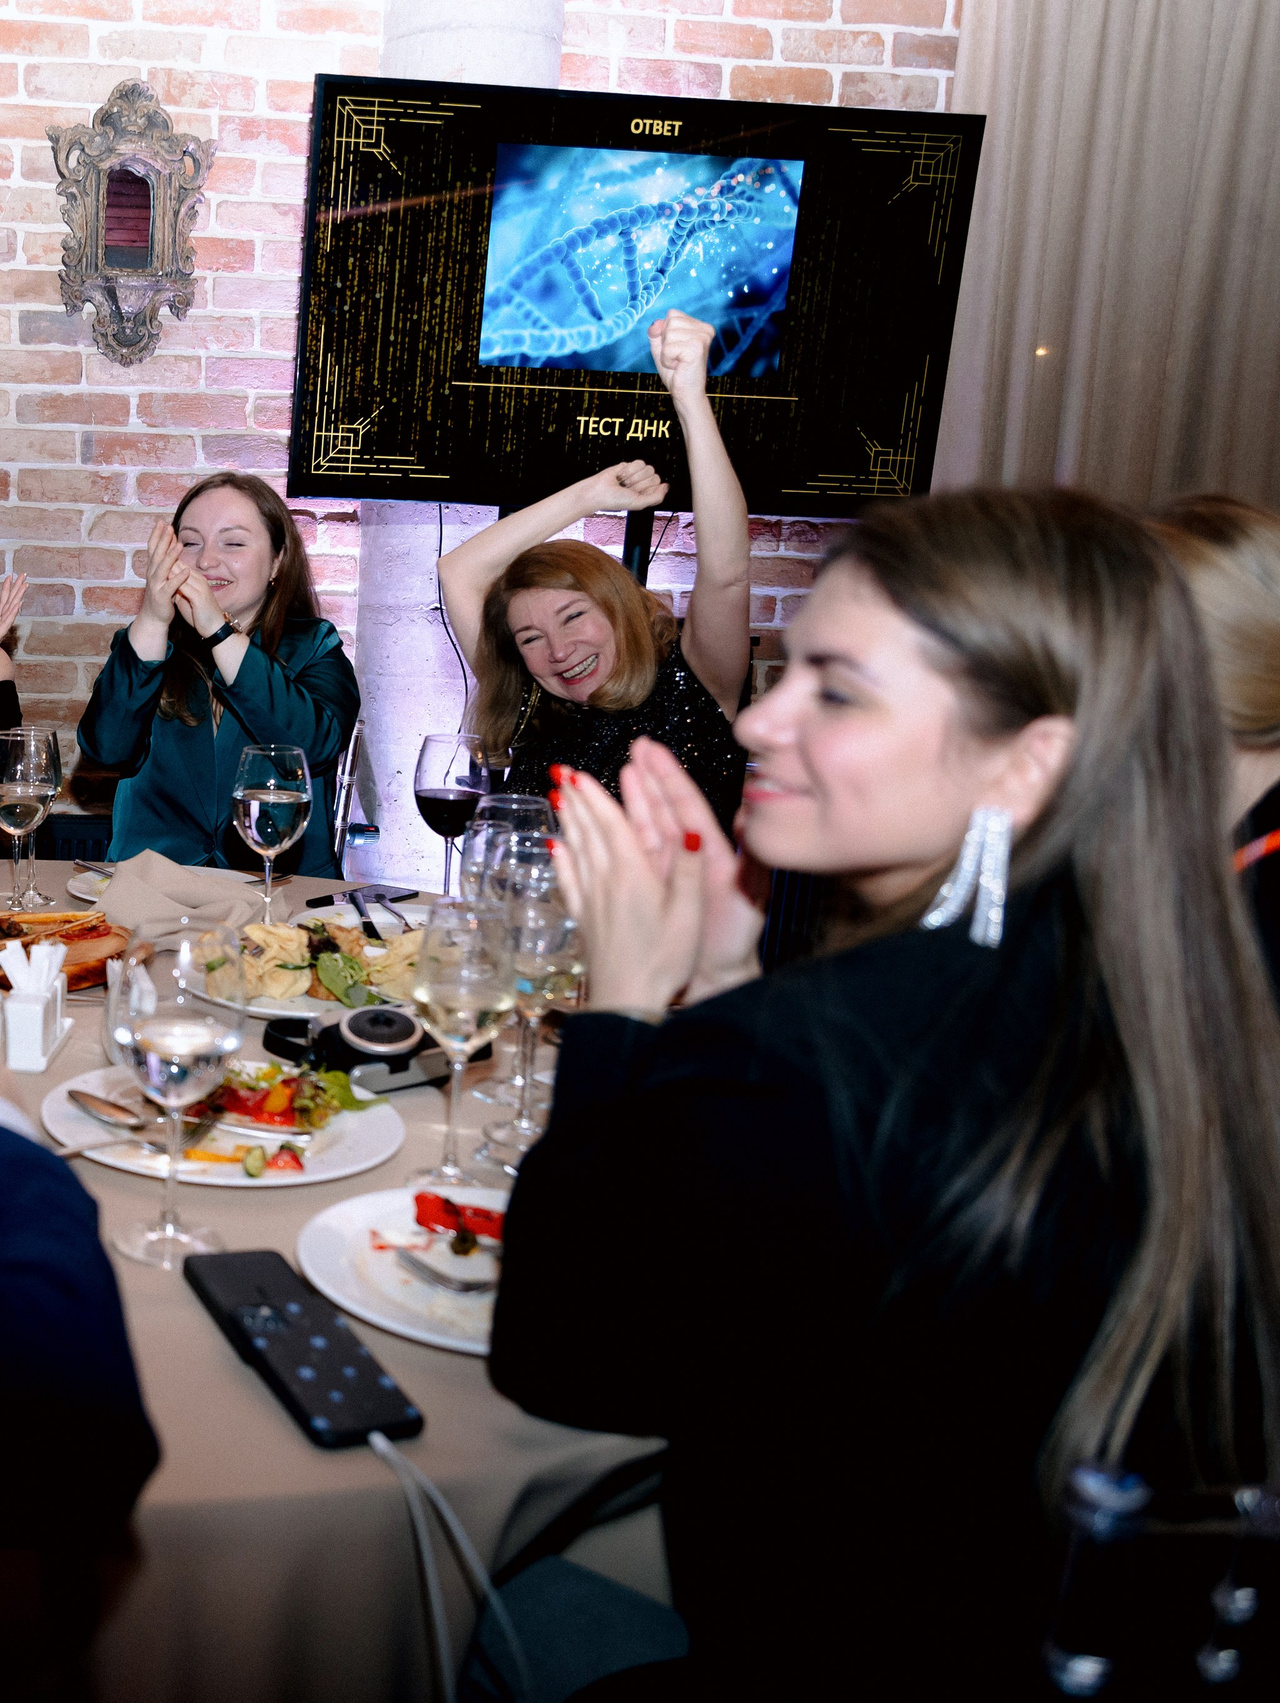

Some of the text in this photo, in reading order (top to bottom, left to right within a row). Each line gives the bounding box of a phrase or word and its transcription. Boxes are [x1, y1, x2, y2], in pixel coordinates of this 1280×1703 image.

[630, 118, 683, 137] ОТВЕТ
[576, 416, 671, 441] ТЕСТ ДНК
